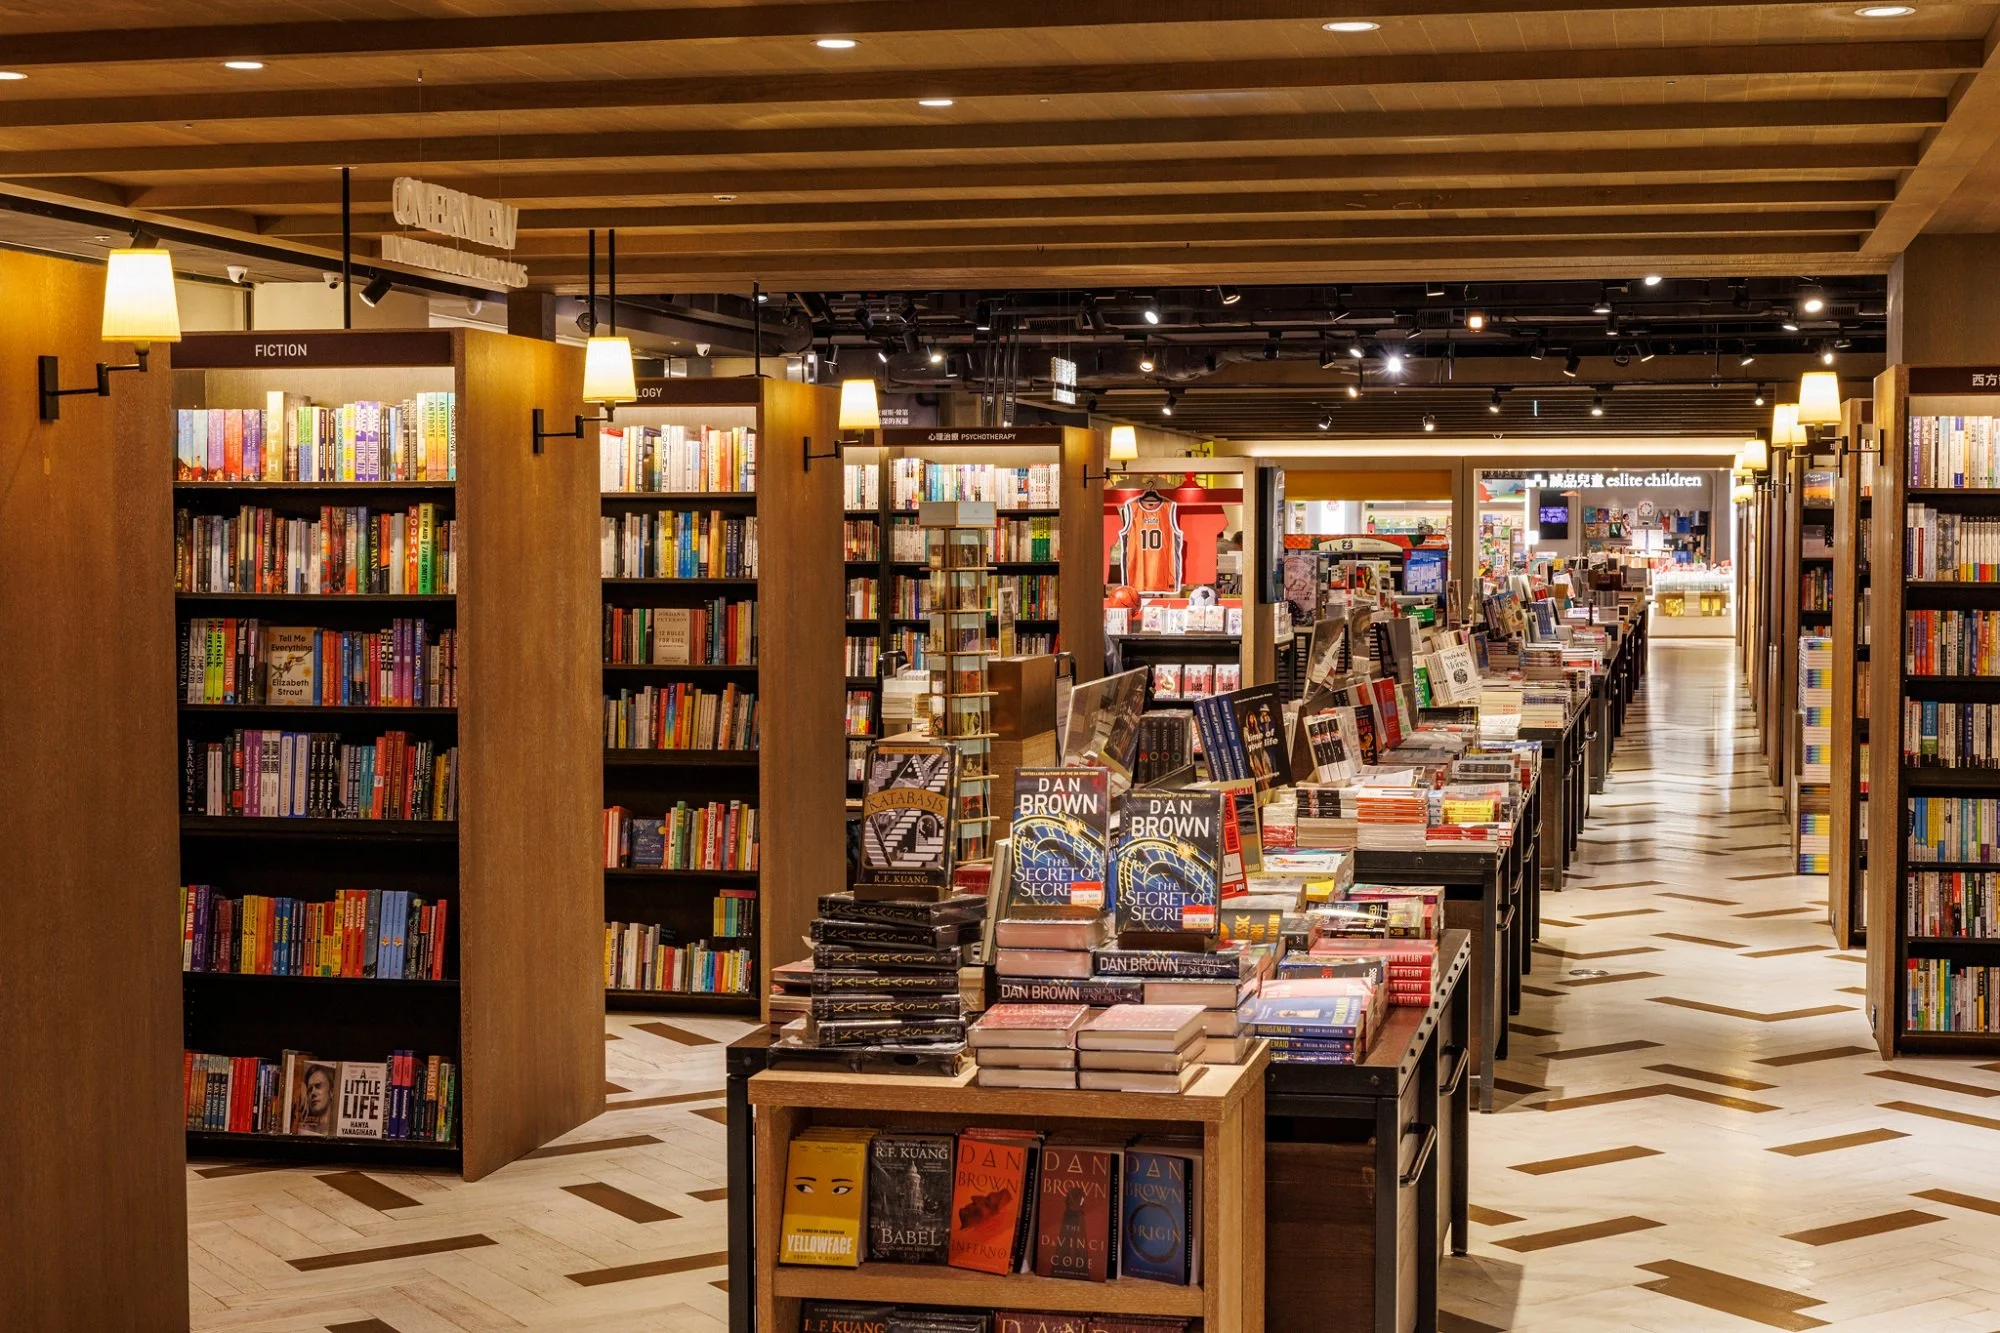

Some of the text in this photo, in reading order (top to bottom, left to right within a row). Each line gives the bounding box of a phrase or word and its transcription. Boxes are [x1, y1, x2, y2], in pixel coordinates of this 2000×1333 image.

[255, 344, 308, 357] FICTION
[1972, 374, 2000, 386] 西方
[928, 433, 959, 441] 心理治療
[1606, 474, 1643, 487] eslite
[1644, 473, 1702, 487] children
[410, 509, 418, 563] RODHAM
[1140, 529, 1162, 550] 10
[206, 620, 214, 668] Heartsick
[215, 620, 224, 668] Heartsick
[271, 644, 313, 652] Everything
[225, 657, 233, 685] LISTENERS
[1446, 660, 1469, 669] Money
[272, 679, 310, 687] Elizabeth
[278, 688, 303, 696] Strout
[1248, 728, 1275, 742] time of
[1248, 738, 1278, 752] your life
[424, 752, 432, 784] COMPANY
[1038, 778, 1080, 792] DAN
[868, 791, 944, 812] KATABASIS
[1020, 794, 1098, 815] BROWN
[1150, 800, 1192, 815] DAN
[1131, 816, 1210, 838] BROWN
[1047, 858, 1070, 866] THE
[874, 875, 928, 884] R.F. KUANG
[1014, 867, 1097, 881] SECRET OF
[1020, 882, 1072, 897] SECRE
[1156, 882, 1181, 891] THE
[1125, 891, 1210, 906] SECRET OF
[186, 892, 195, 932] KIT WAAL
[832, 904, 913, 918] KATABASIS
[1130, 906, 1183, 921] SECRE
[827, 929, 918, 943] KATABASIS
[832, 952, 936, 963] KATABASIS
[1399, 954, 1423, 964] O'LEARY
[1100, 957, 1179, 973] DAN BROWN
[1399, 969, 1423, 978] O'LEARY
[832, 978, 937, 988] KATABASIS
[1399, 983, 1423, 992] O'LEARY
[1001, 984, 1080, 1001] DAN BROWN
[833, 1002, 940, 1012] KATABASIS
[1399, 996, 1423, 1005] O'LEARY
[840, 1027, 946, 1039] KATABASIS
[1270, 1040, 1289, 1048] EMAID
[360, 1070, 366, 1079] A
[427, 1060, 437, 1096] THRUST
[344, 1080, 380, 1095] LITTLE
[343, 1095, 379, 1120] LIFE
[341, 1128, 377, 1136] YANAGIHARA
[875, 1148, 948, 1159] R.F. KUANG
[960, 1144, 1022, 1172] DAN
[1044, 1151, 1108, 1176] DAN
[1126, 1155, 1182, 1181] DAN
[957, 1170, 1019, 1193] BROWN
[1043, 1179, 1107, 1199] BROWN
[1125, 1180, 1183, 1203] BROWN
[1065, 1224, 1080, 1232] THE
[1128, 1224, 1182, 1243] ORIGIN
[787, 1234, 853, 1254] YELLOWFACE
[881, 1228, 941, 1246] BABEL
[951, 1239, 1007, 1259] INFERNO
[1050, 1255, 1094, 1270] CODE
[832, 1321, 885, 1333] KUANG
